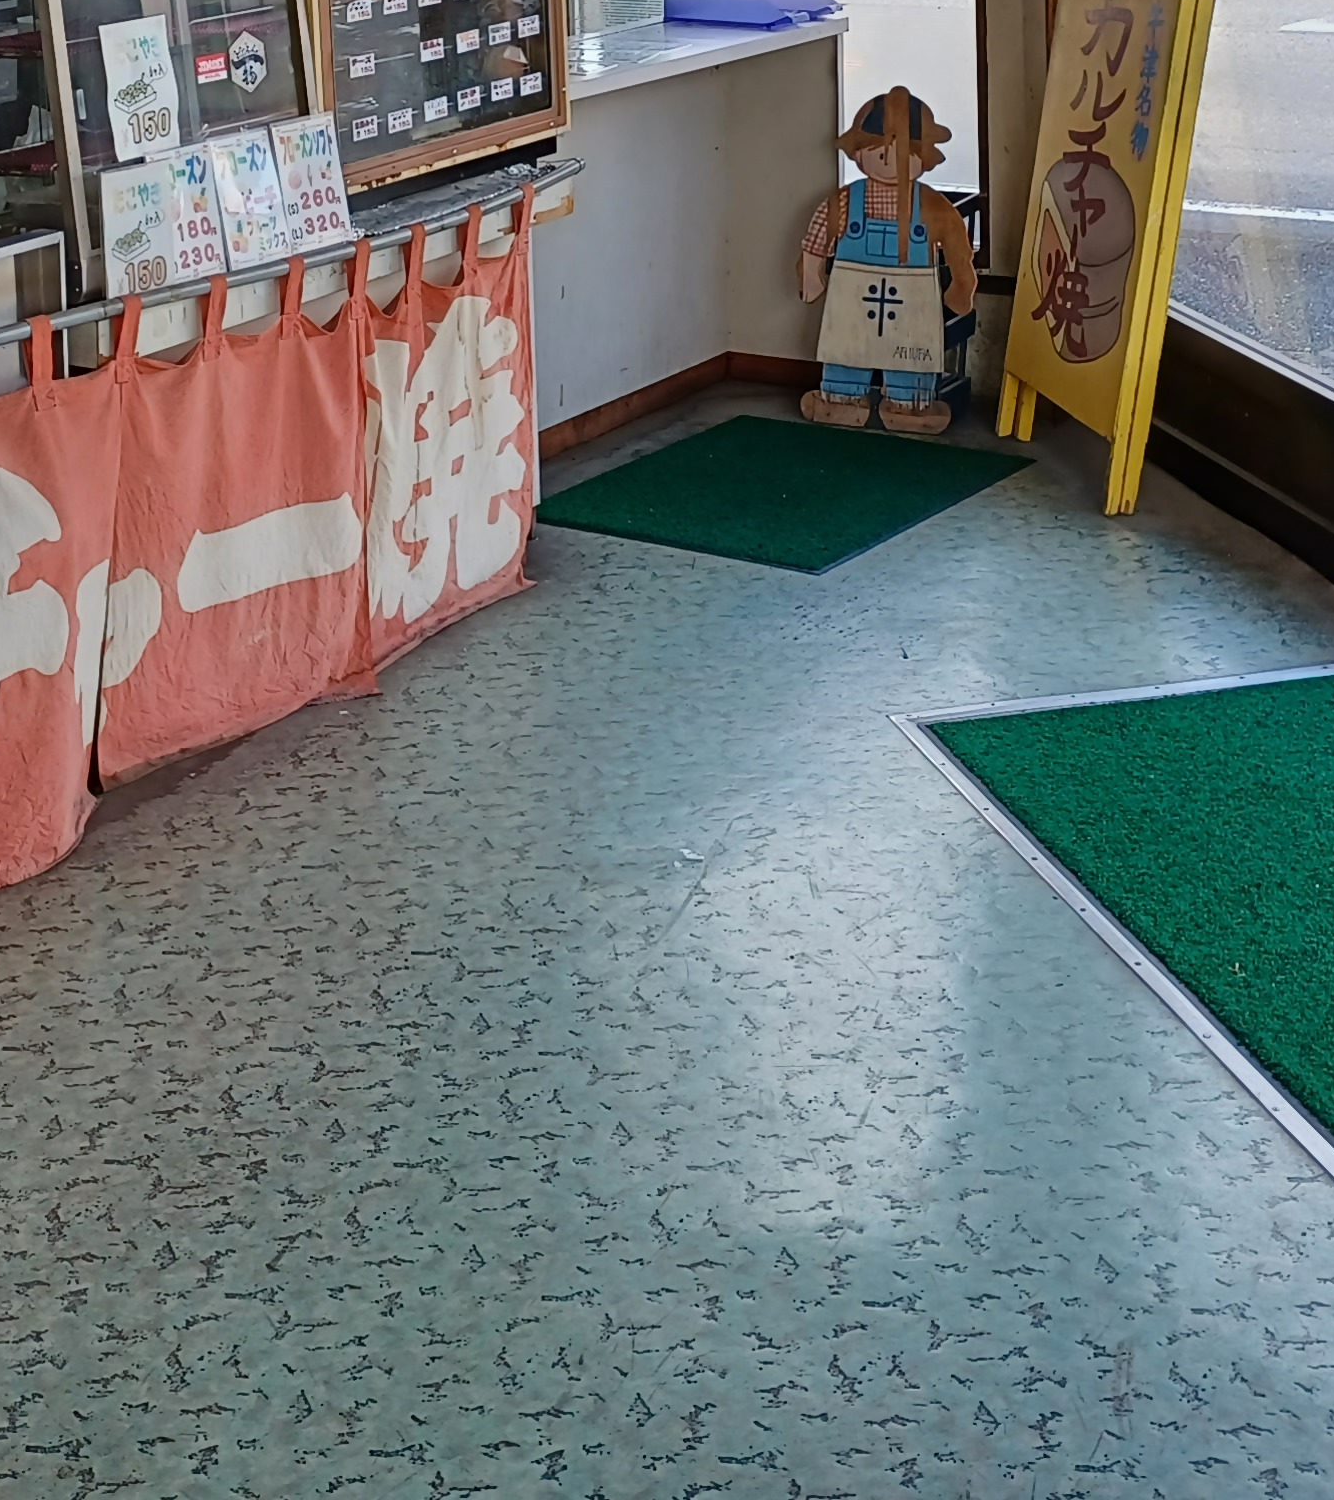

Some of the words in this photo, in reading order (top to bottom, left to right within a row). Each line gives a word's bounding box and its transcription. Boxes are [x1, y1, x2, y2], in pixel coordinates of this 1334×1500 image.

[1031, 3, 1135, 358] カルチャー焼
